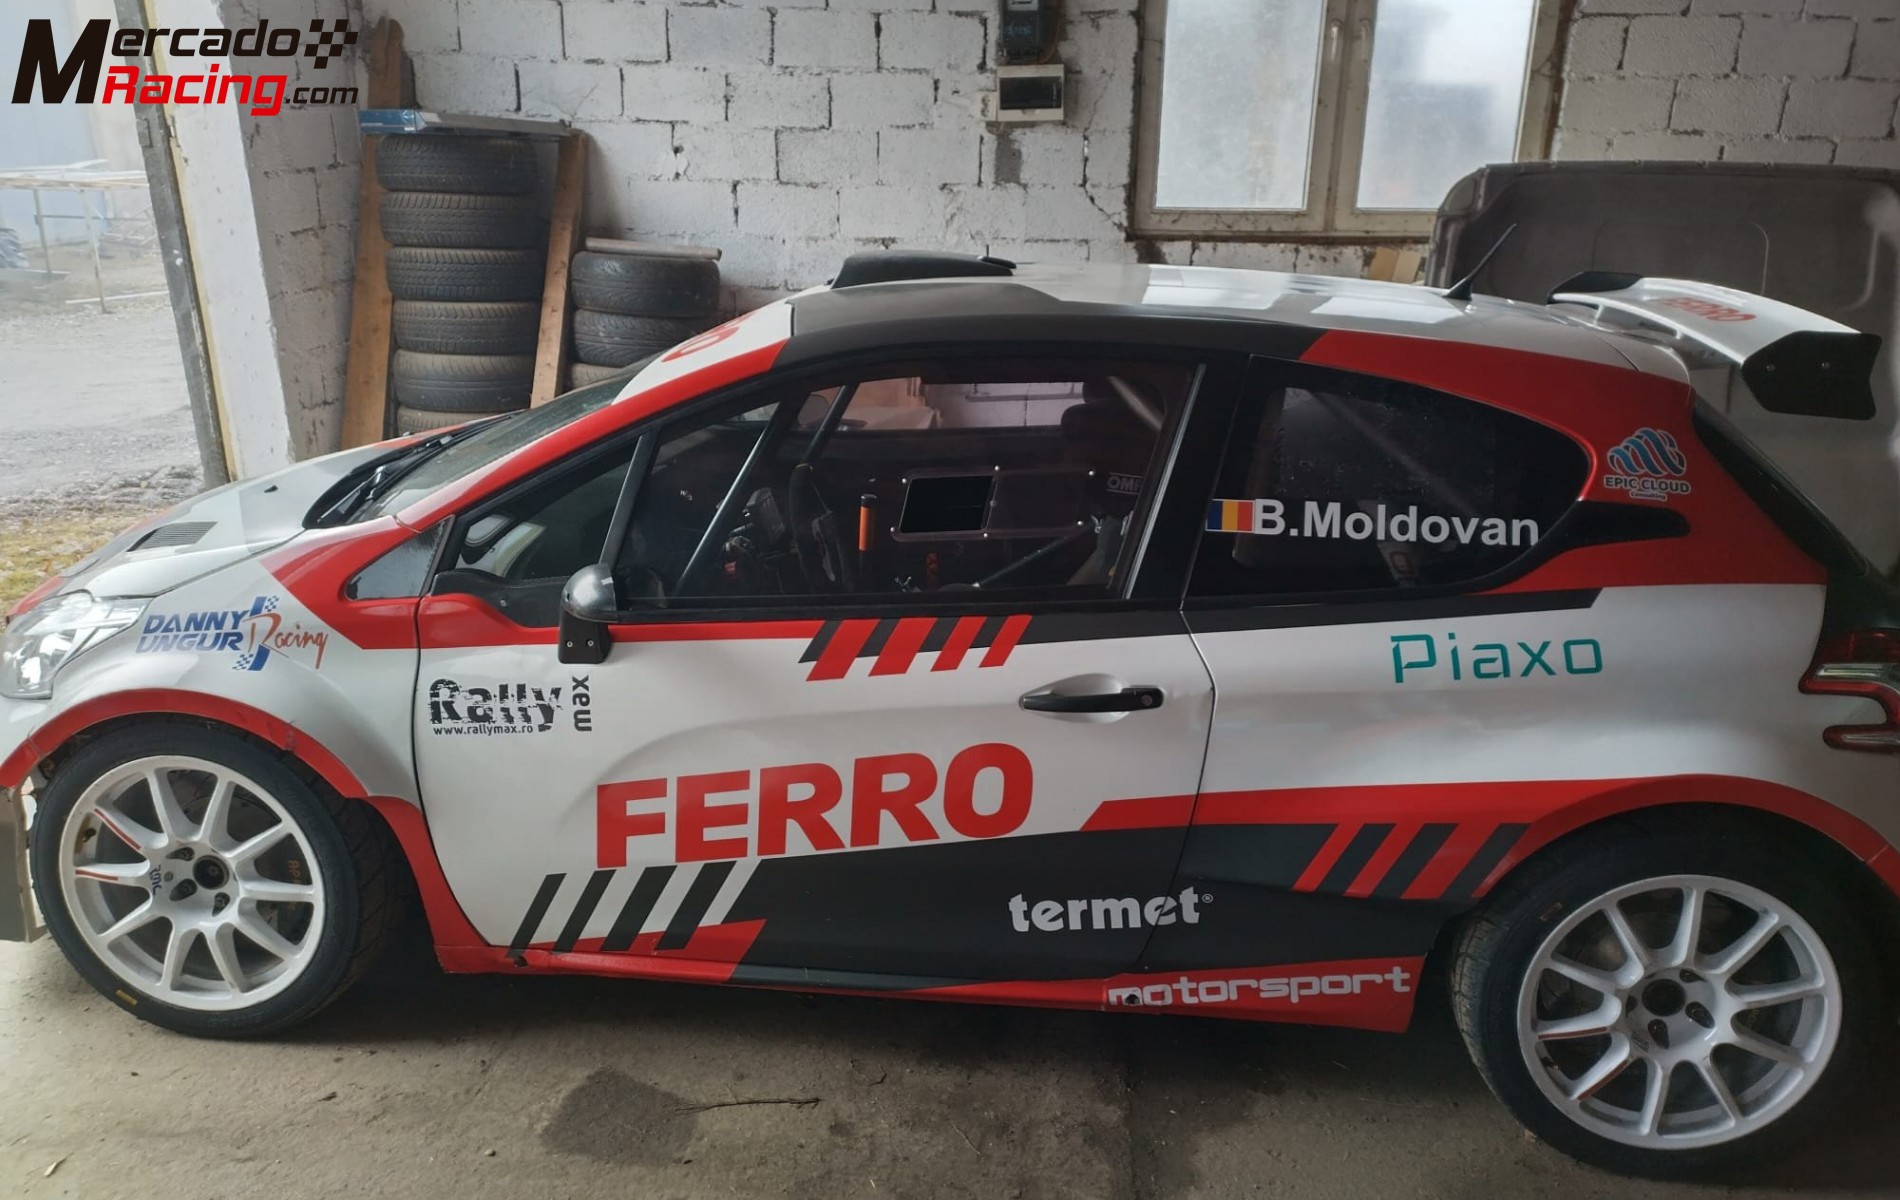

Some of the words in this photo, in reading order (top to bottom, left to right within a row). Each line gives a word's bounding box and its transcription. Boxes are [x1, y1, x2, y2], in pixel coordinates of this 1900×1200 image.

[1605, 476, 1638, 489] EPIC
[1641, 480, 1690, 493] CLOUD
[1254, 498, 1540, 547] B.Moldovan
[135, 631, 244, 654] UNGUR
[143, 610, 249, 634] DANNY
[242, 612, 329, 670] Racing
[1390, 632, 1603, 684] Piaxo
[428, 678, 563, 732] Rally
[572, 675, 593, 732] max
[433, 724, 534, 736] www.rallymax.ro
[597, 742, 1033, 869] FERRO
[1108, 966, 1410, 1006] motorsport
